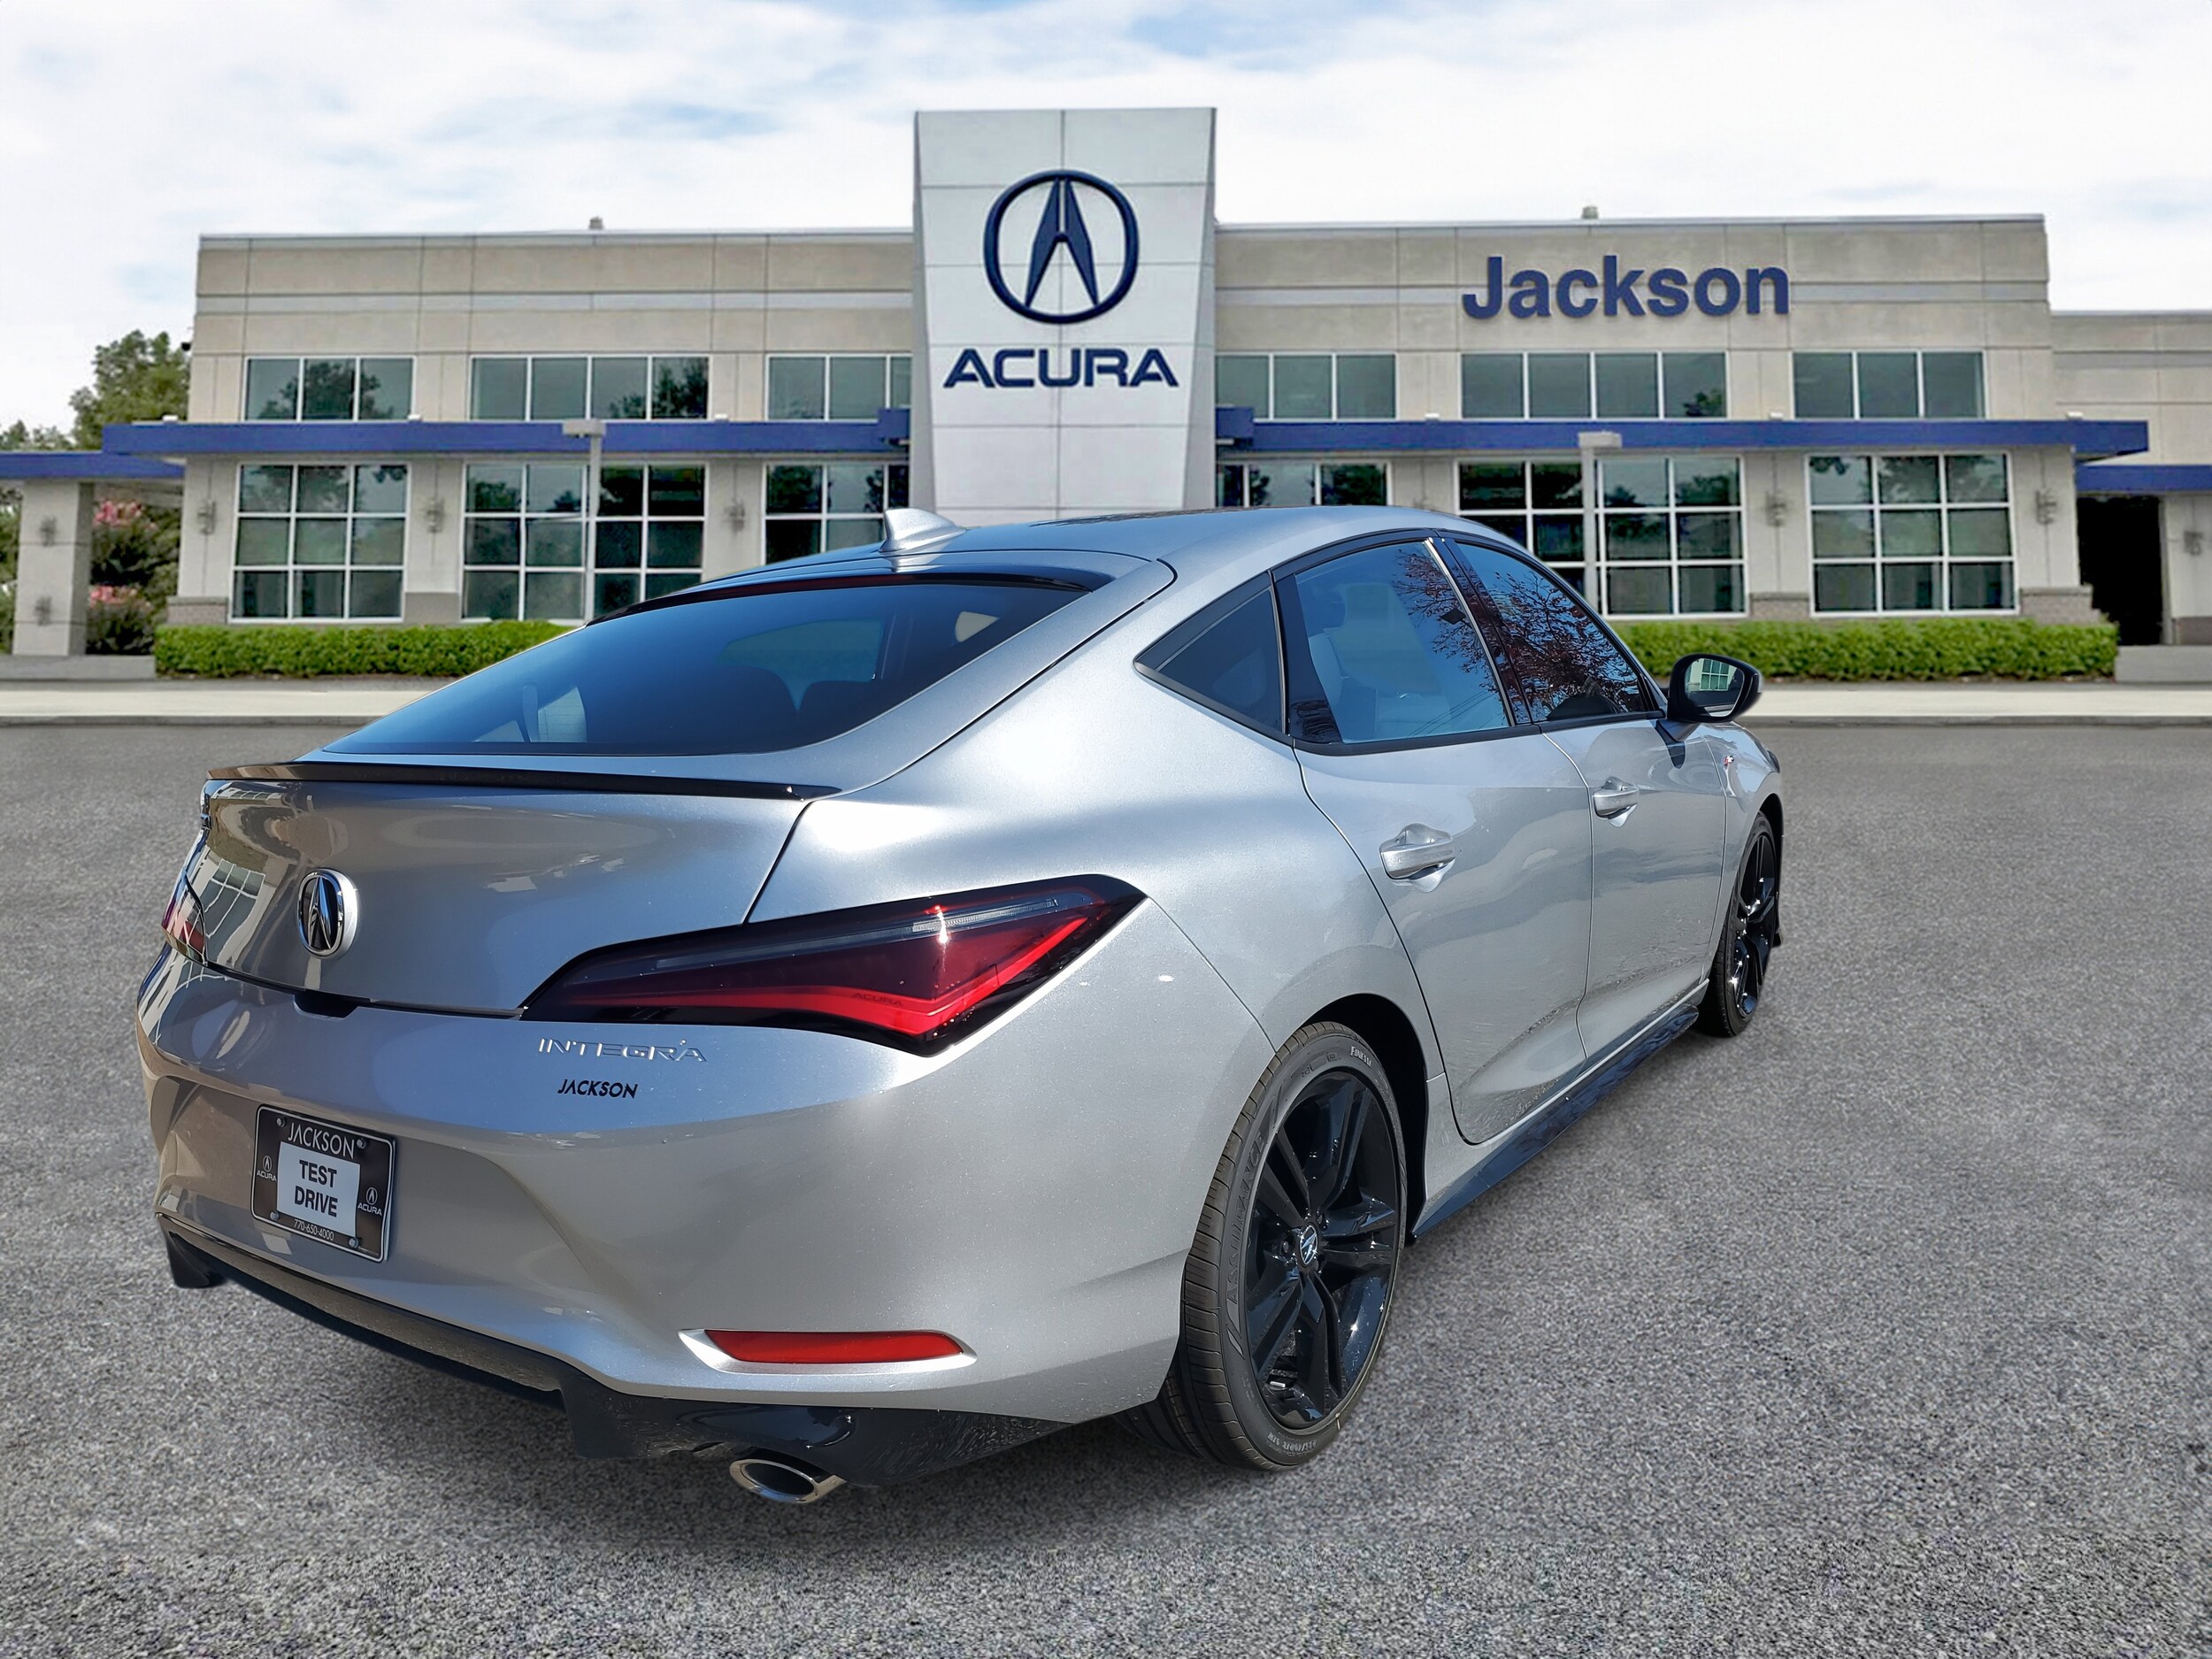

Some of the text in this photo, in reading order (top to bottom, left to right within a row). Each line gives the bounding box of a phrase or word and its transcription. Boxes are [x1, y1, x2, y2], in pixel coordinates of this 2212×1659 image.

[1463, 255, 1789, 319] Jackson
[943, 349, 1179, 388] ACURA
[539, 1038, 707, 1062] INTEGRA
[557, 1079, 638, 1099] JACKSON
[288, 1123, 355, 1159] JACKSON
[257, 1170, 278, 1182] ACURA
[299, 1159, 337, 1187] TEST
[294, 1186, 338, 1217] DRIVE
[357, 1202, 382, 1216] ACURA
[294, 1218, 334, 1241] 770-650-4000
